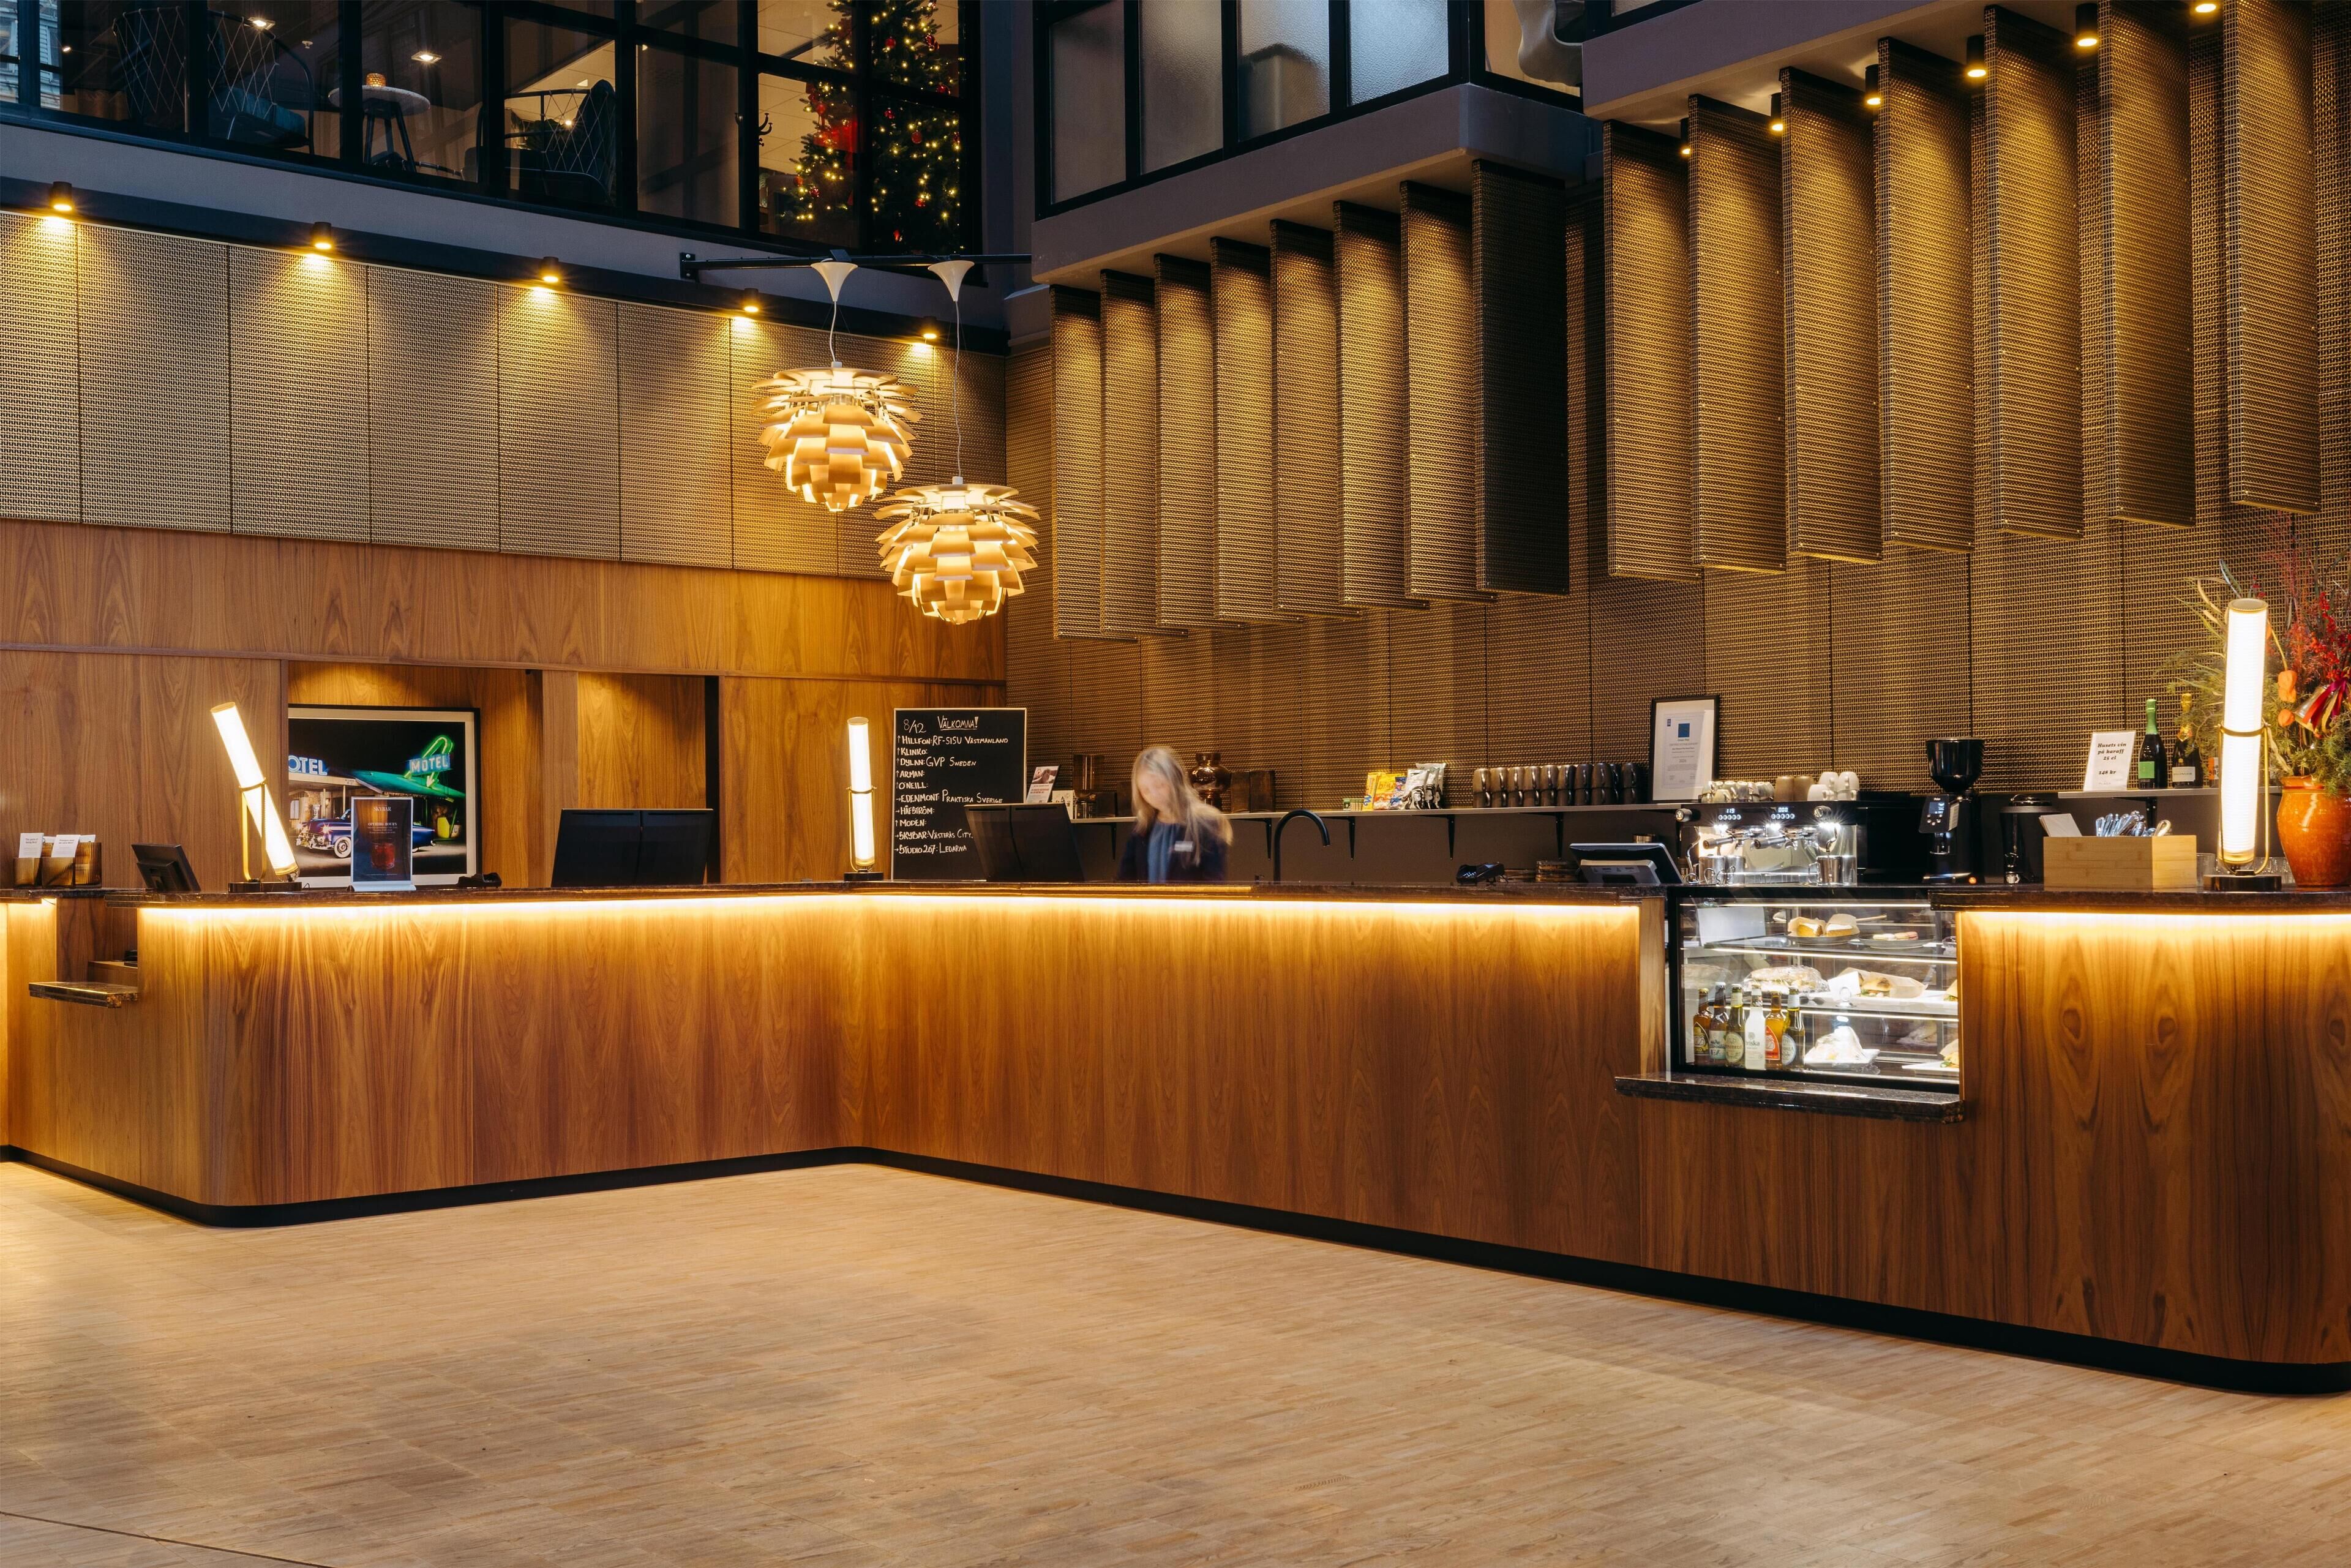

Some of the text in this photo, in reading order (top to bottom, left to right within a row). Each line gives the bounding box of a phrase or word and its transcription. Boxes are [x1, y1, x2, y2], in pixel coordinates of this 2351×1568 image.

[904, 715, 979, 733] 8/12 VÄLKOMNA!
[932, 735, 962, 746] RF-SISU
[411, 756, 449, 773] MOTEL
[926, 757, 945, 767] GVP
[950, 757, 977, 767] SWEDEN
[942, 789, 973, 803] PRAKTISKA
[977, 792, 1003, 803] SVERIGE
[928, 830, 955, 839] VÄSTERÅS
[899, 844, 922, 854] STUDIO
[939, 842, 967, 853] LEDARNA
